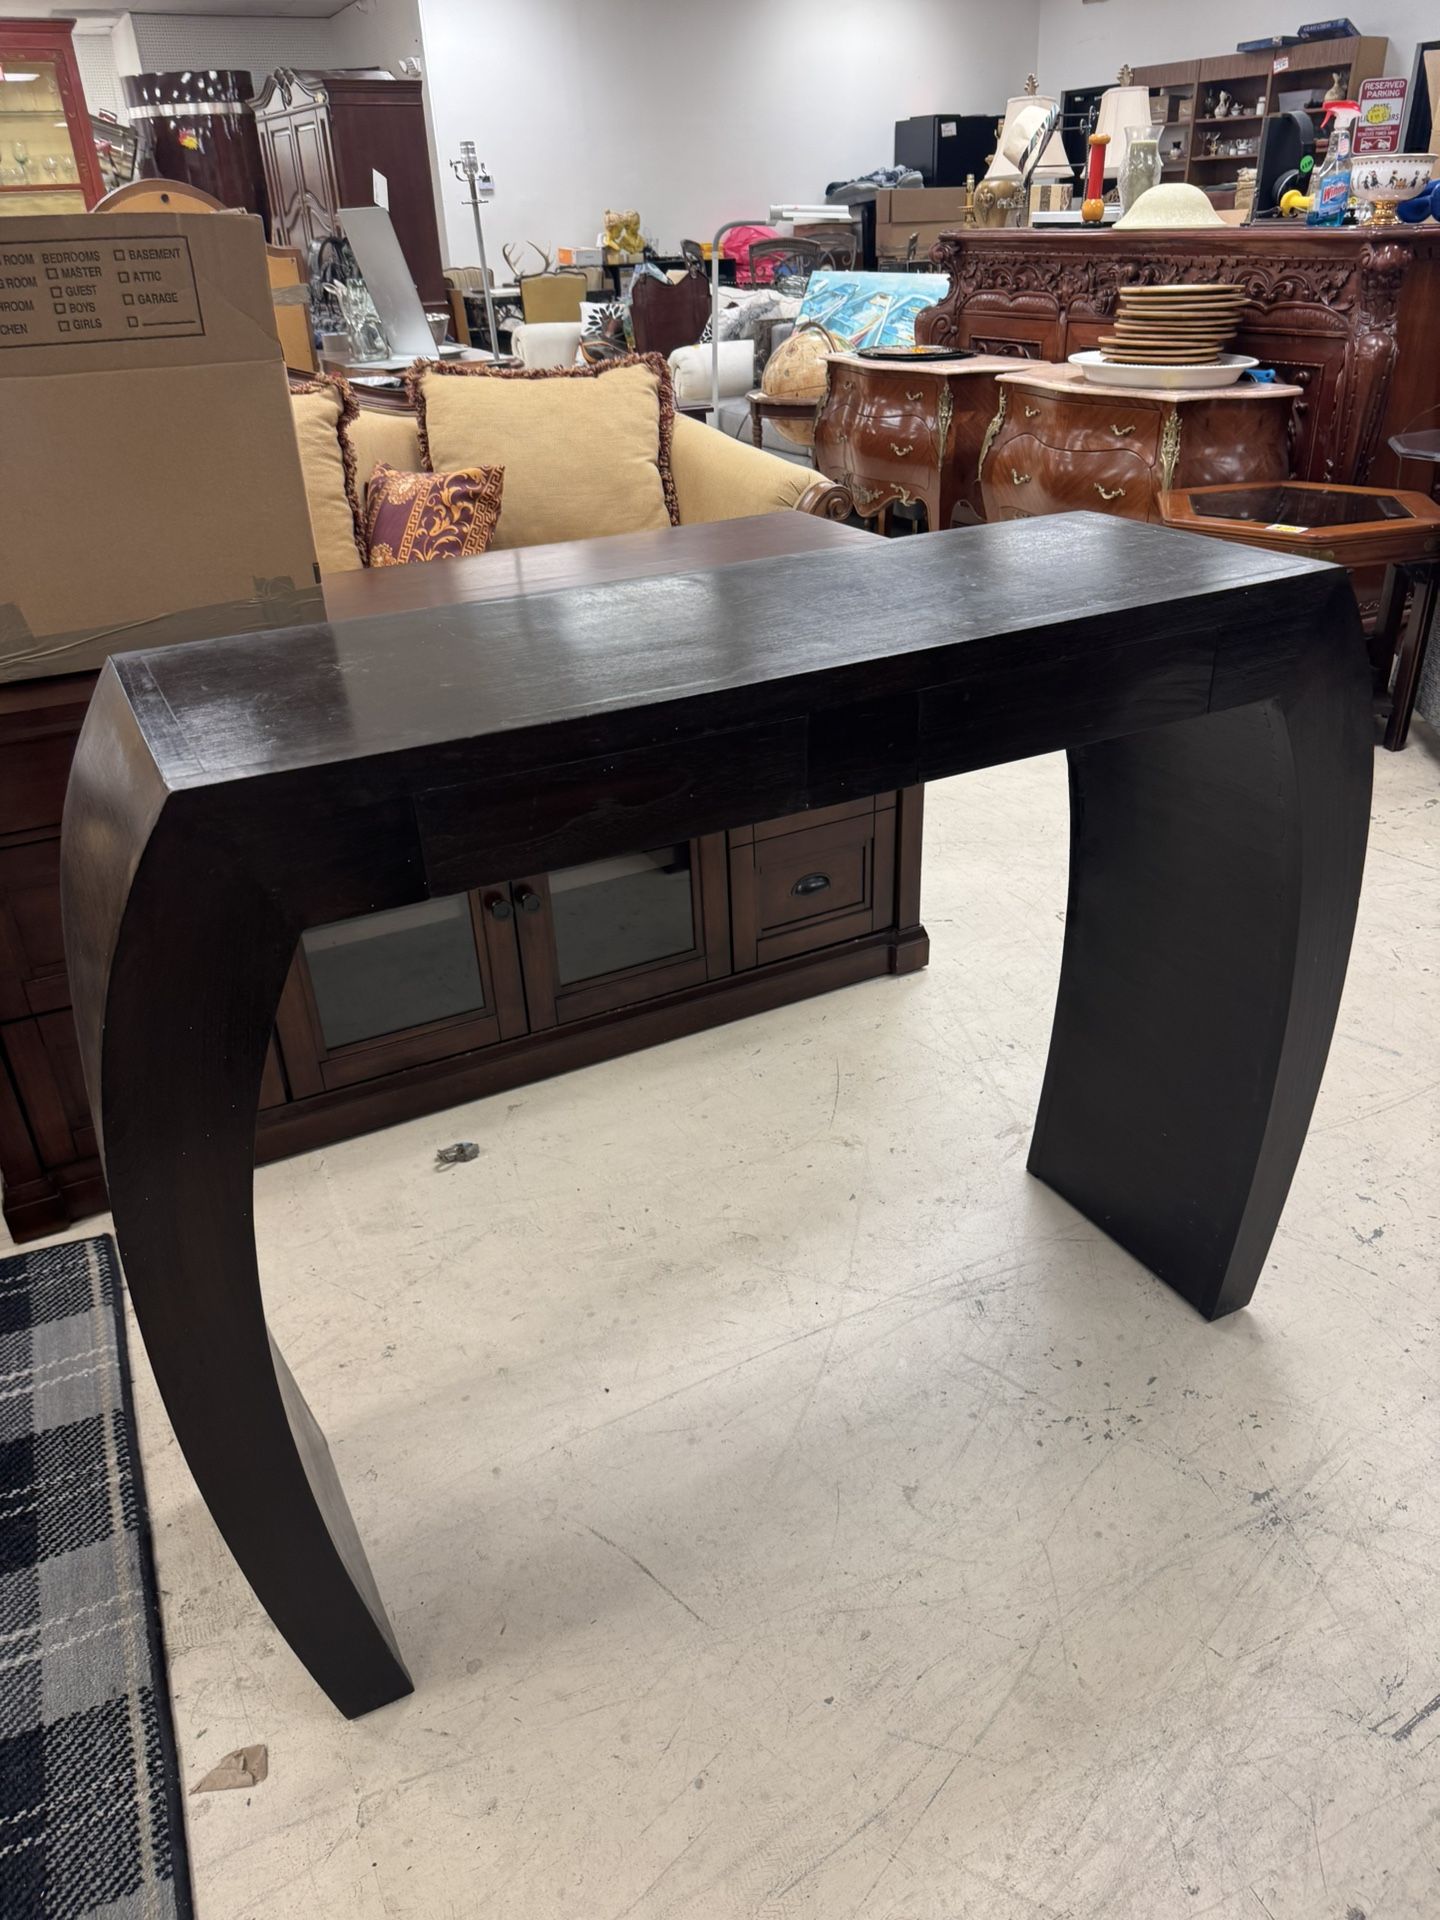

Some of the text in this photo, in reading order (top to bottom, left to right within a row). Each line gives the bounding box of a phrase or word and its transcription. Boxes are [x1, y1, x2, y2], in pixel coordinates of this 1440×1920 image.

[1364, 81, 1405, 90] RESERVED
[1366, 89, 1400, 98] PARKING
[3, 254, 35, 266] ROOM
[42, 251, 100, 264] BEDROOMS
[129, 248, 180, 261] BASEMENT
[61, 266, 102, 279] MASTER
[133, 271, 162, 283] ATTIC
[6, 276, 38, 289] ROOM
[65, 285, 97, 297] GUEST
[138, 292, 178, 305] GARAGE
[69, 302, 96, 314] BOYS
[73, 319, 102, 330] GIRLS
